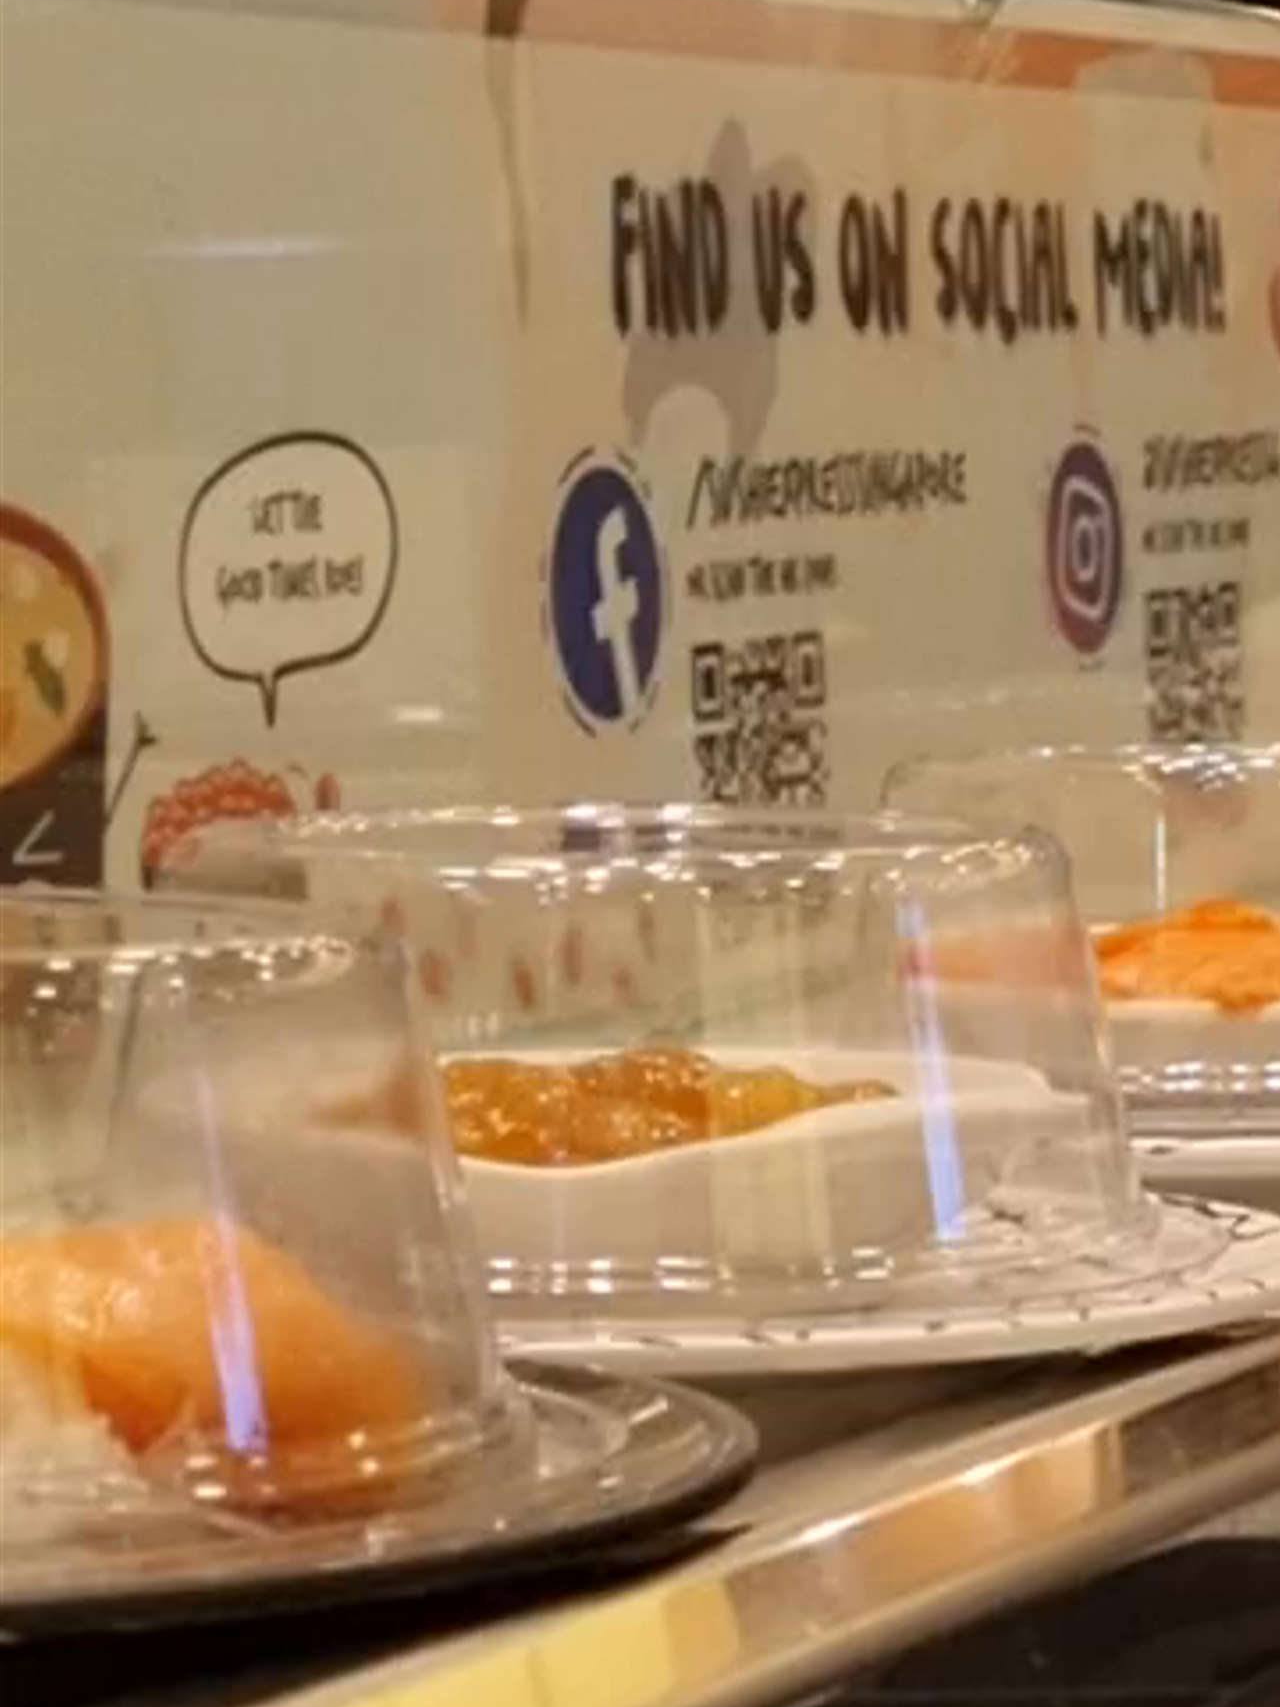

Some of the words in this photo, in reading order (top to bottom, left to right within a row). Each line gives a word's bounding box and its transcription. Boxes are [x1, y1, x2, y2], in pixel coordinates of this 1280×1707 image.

[610, 174, 730, 340] FIND
[751, 186, 816, 336] US
[838, 185, 910, 339] ON
[930, 195, 1079, 346] SOCIAL
[1093, 196, 1226, 339] MEDIA!
